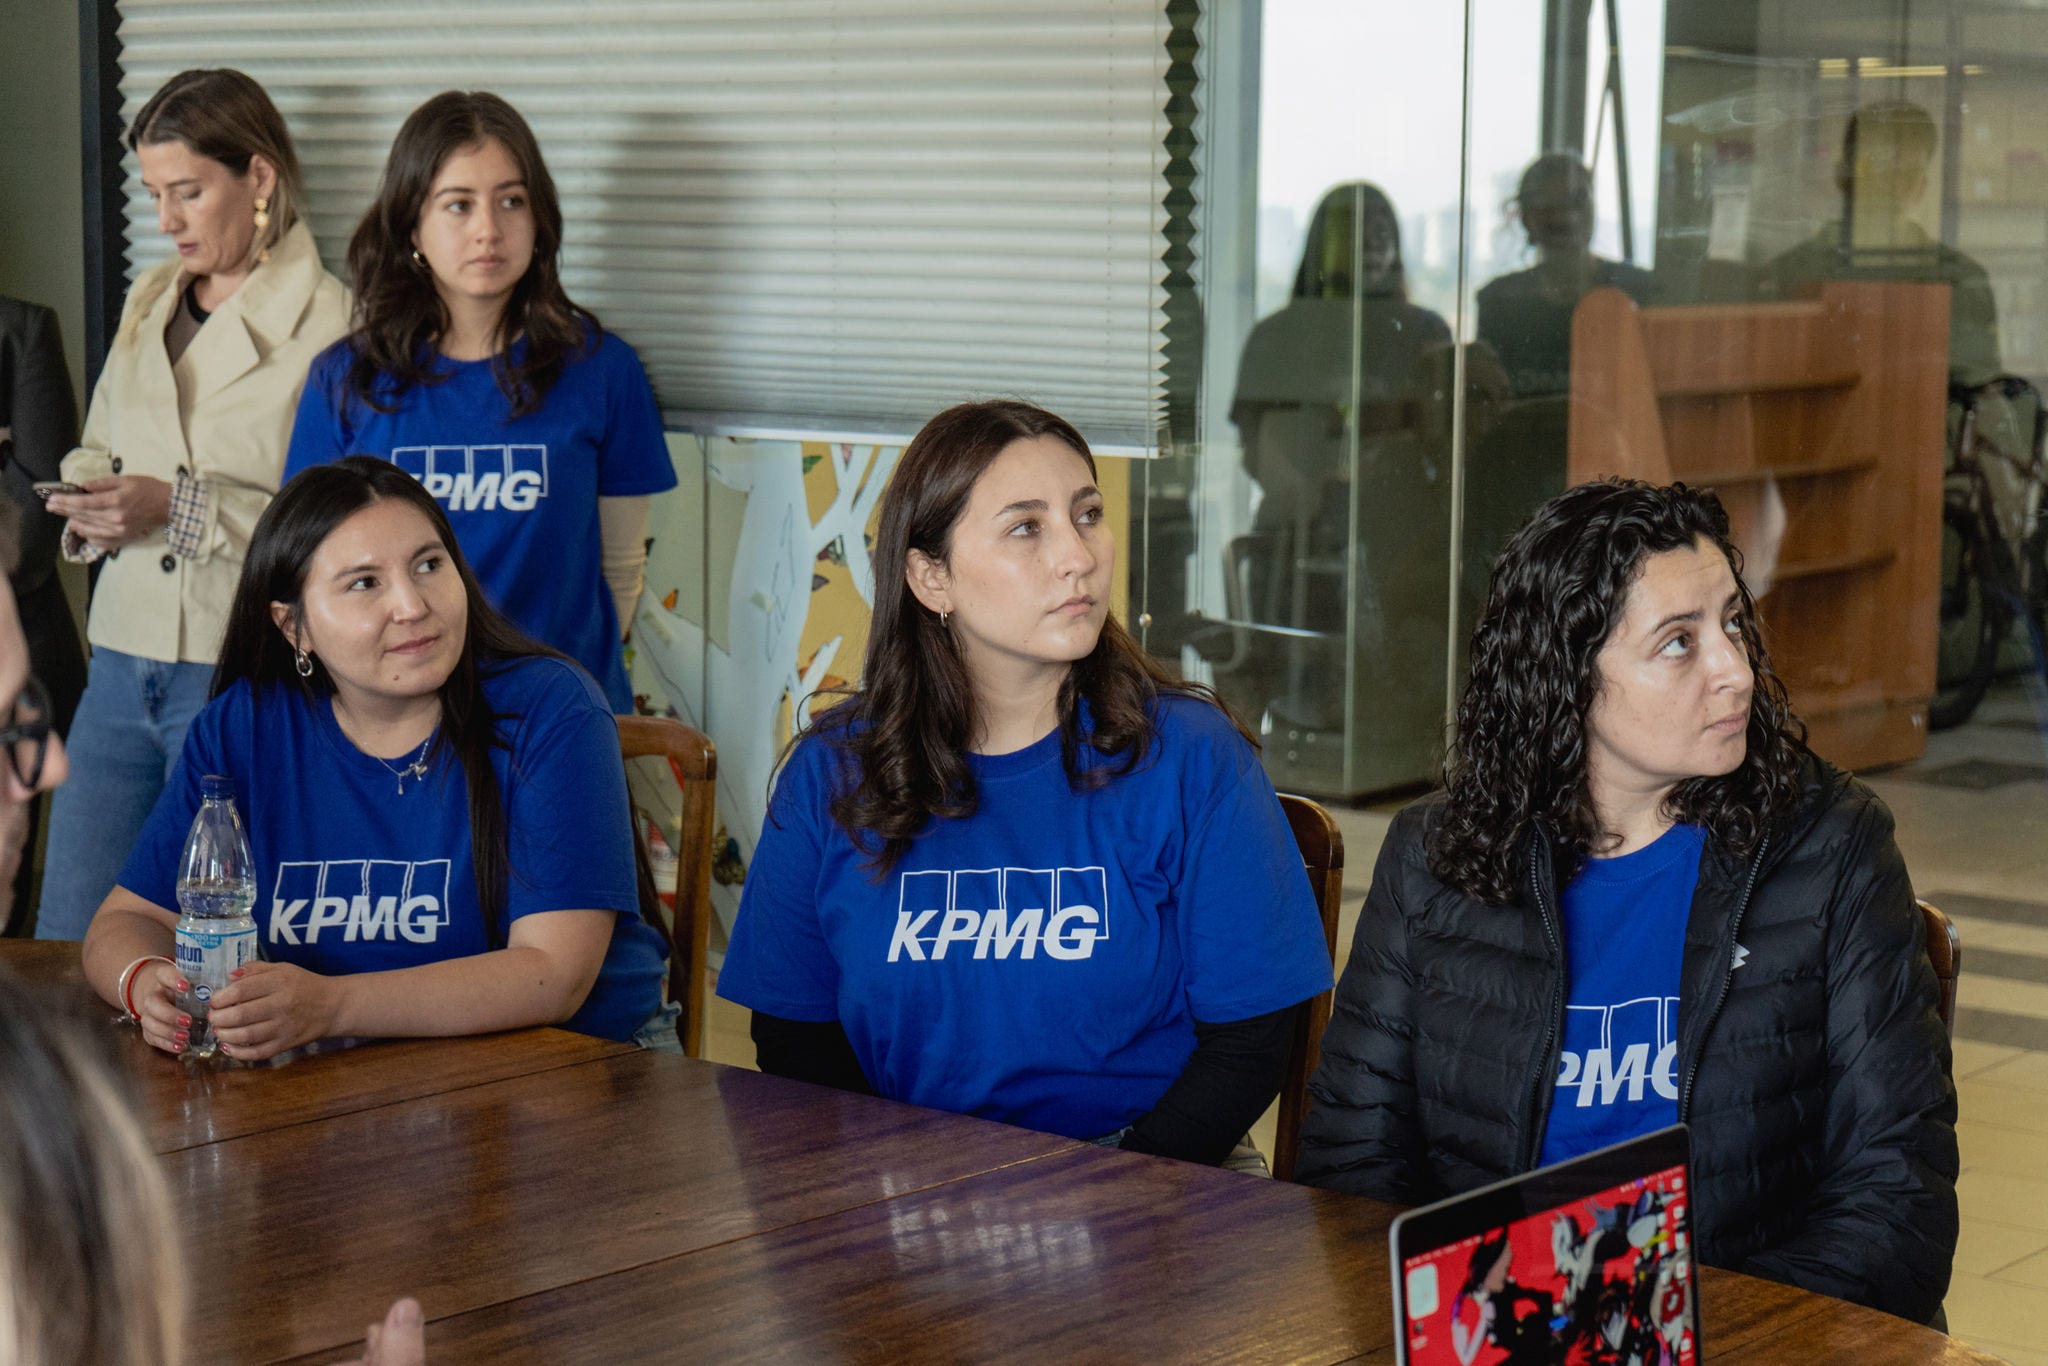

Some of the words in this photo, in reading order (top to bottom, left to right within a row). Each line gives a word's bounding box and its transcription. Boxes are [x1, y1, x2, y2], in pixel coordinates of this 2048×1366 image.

[410, 470, 542, 511] PMG
[269, 894, 440, 945] KPMG
[887, 904, 1100, 963] KPMG
[176, 943, 202, 963] ntun
